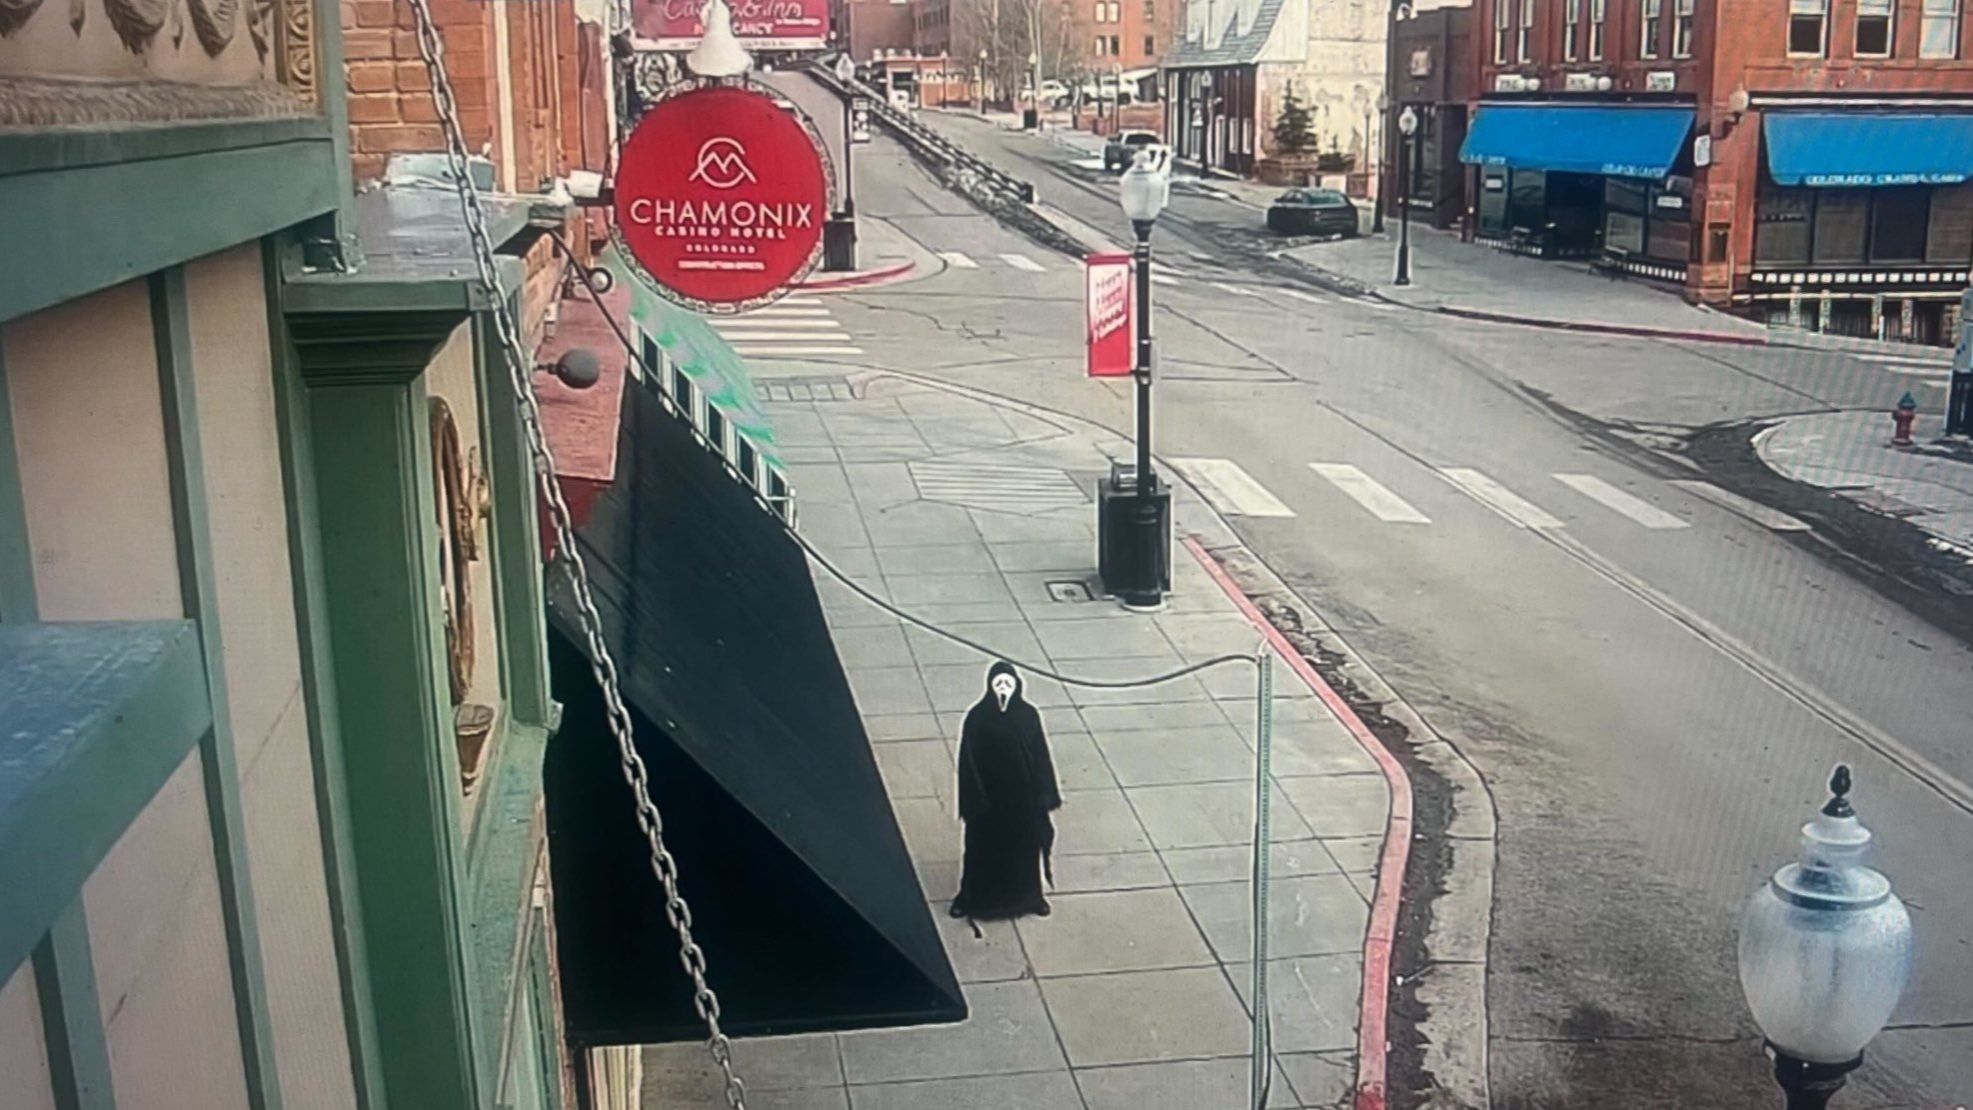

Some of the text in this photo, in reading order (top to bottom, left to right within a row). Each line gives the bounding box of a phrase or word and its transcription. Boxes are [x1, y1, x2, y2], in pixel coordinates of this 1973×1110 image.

[630, 199, 812, 228] CHAMONIX
[655, 226, 786, 239] CASINO HOTEL
